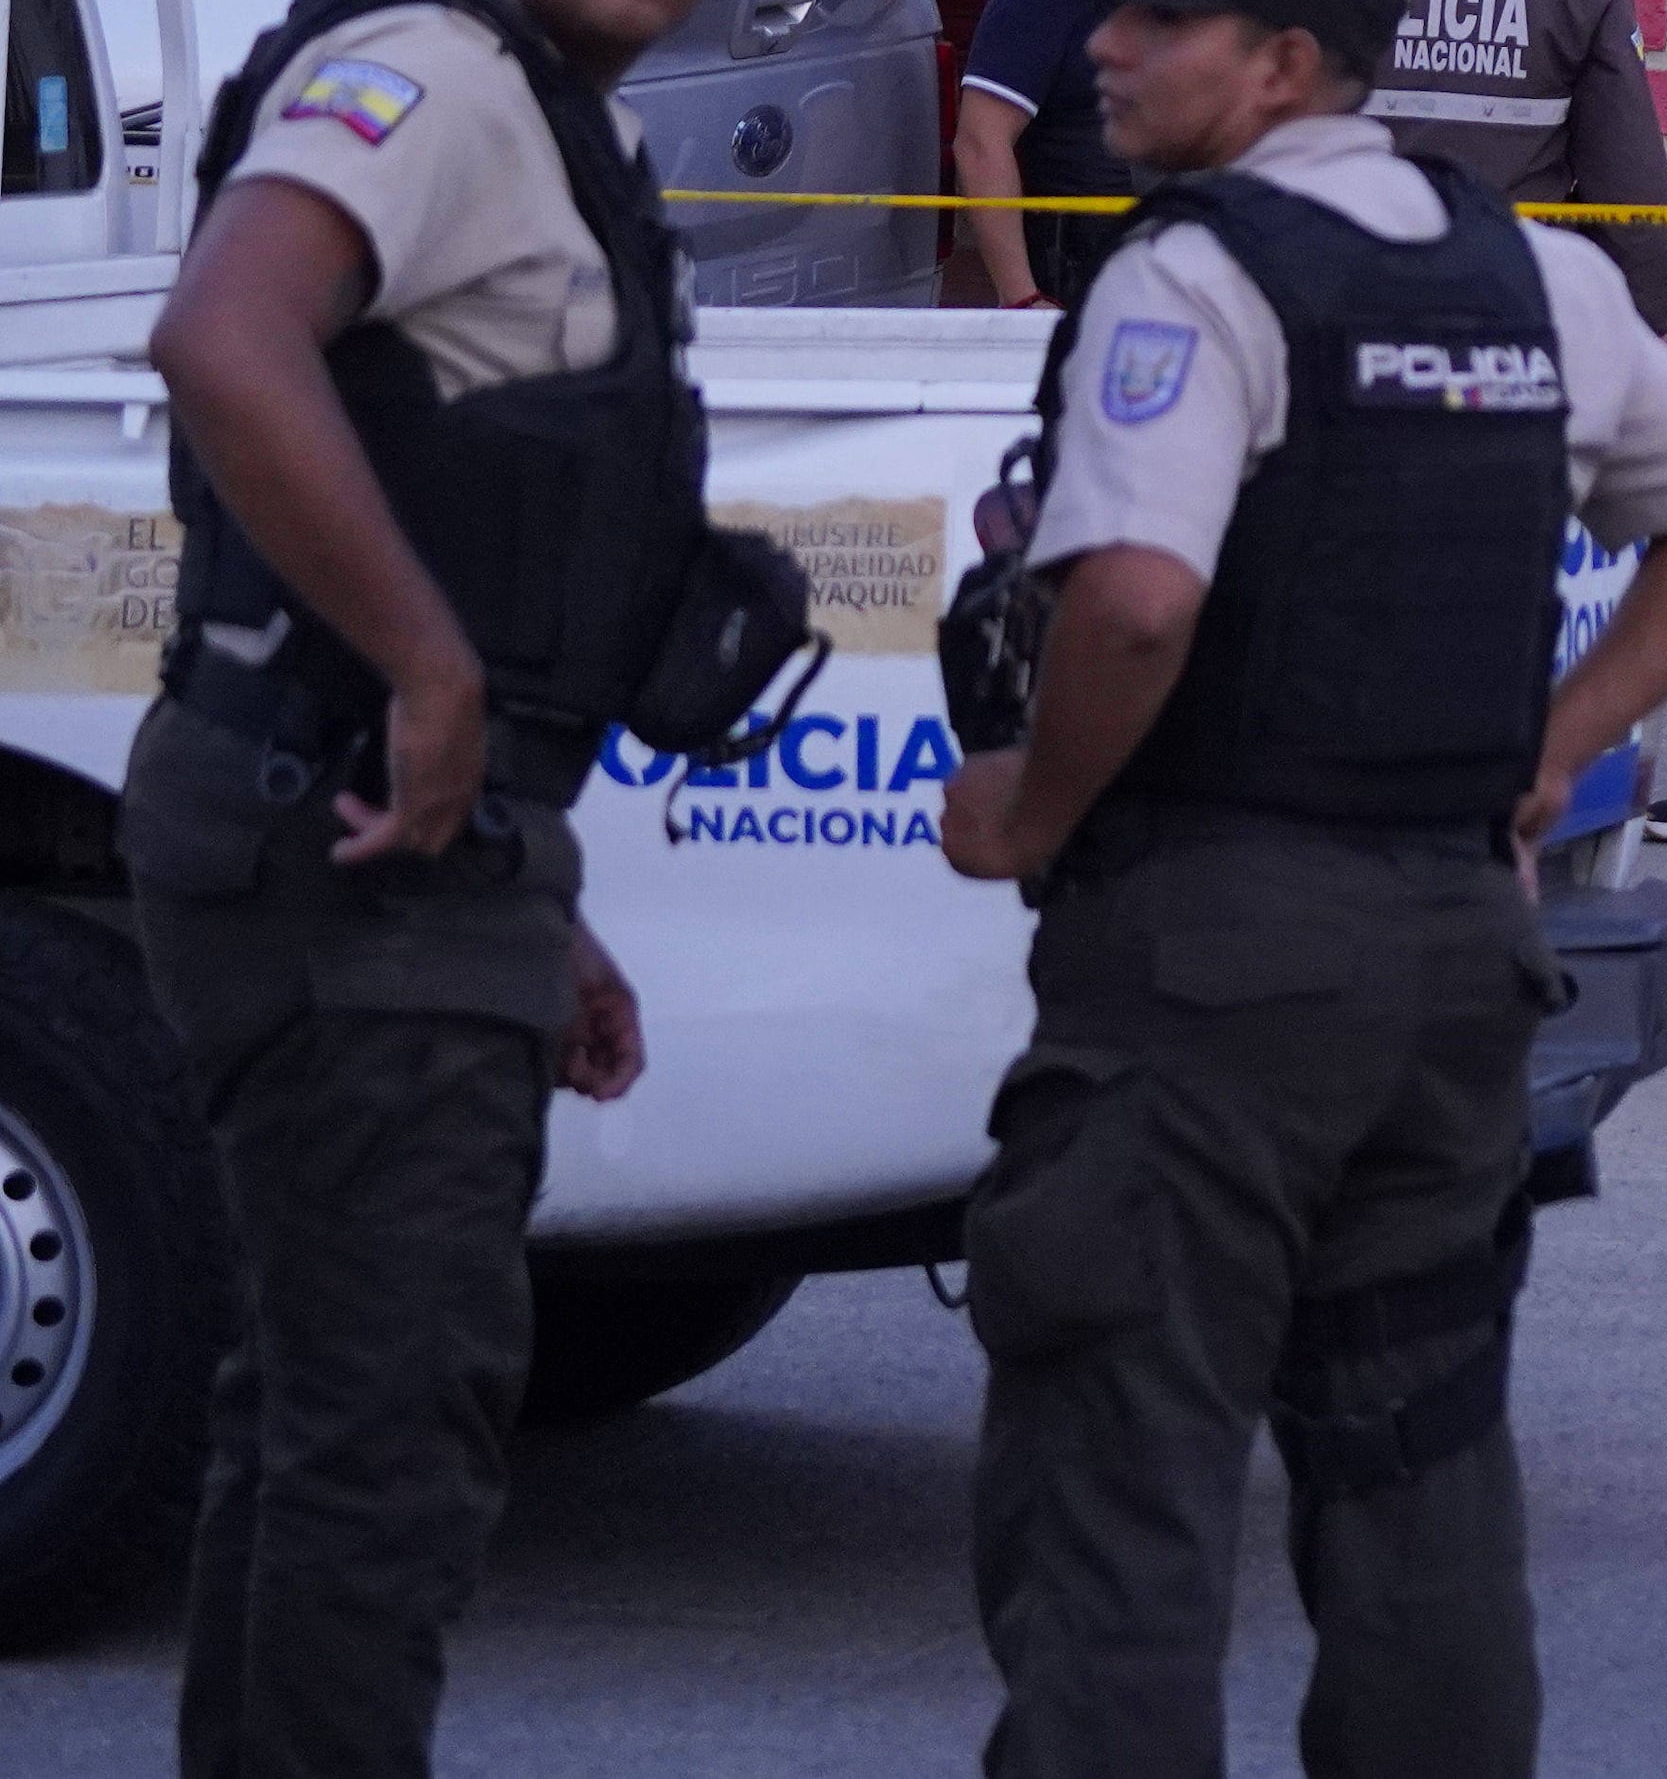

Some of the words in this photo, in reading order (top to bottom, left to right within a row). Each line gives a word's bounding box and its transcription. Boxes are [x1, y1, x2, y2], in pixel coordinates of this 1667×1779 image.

[1394, 38, 1528, 79] NACIONAL
[128, 518, 165, 551] EL
[690, 804, 938, 846] NACIONA
